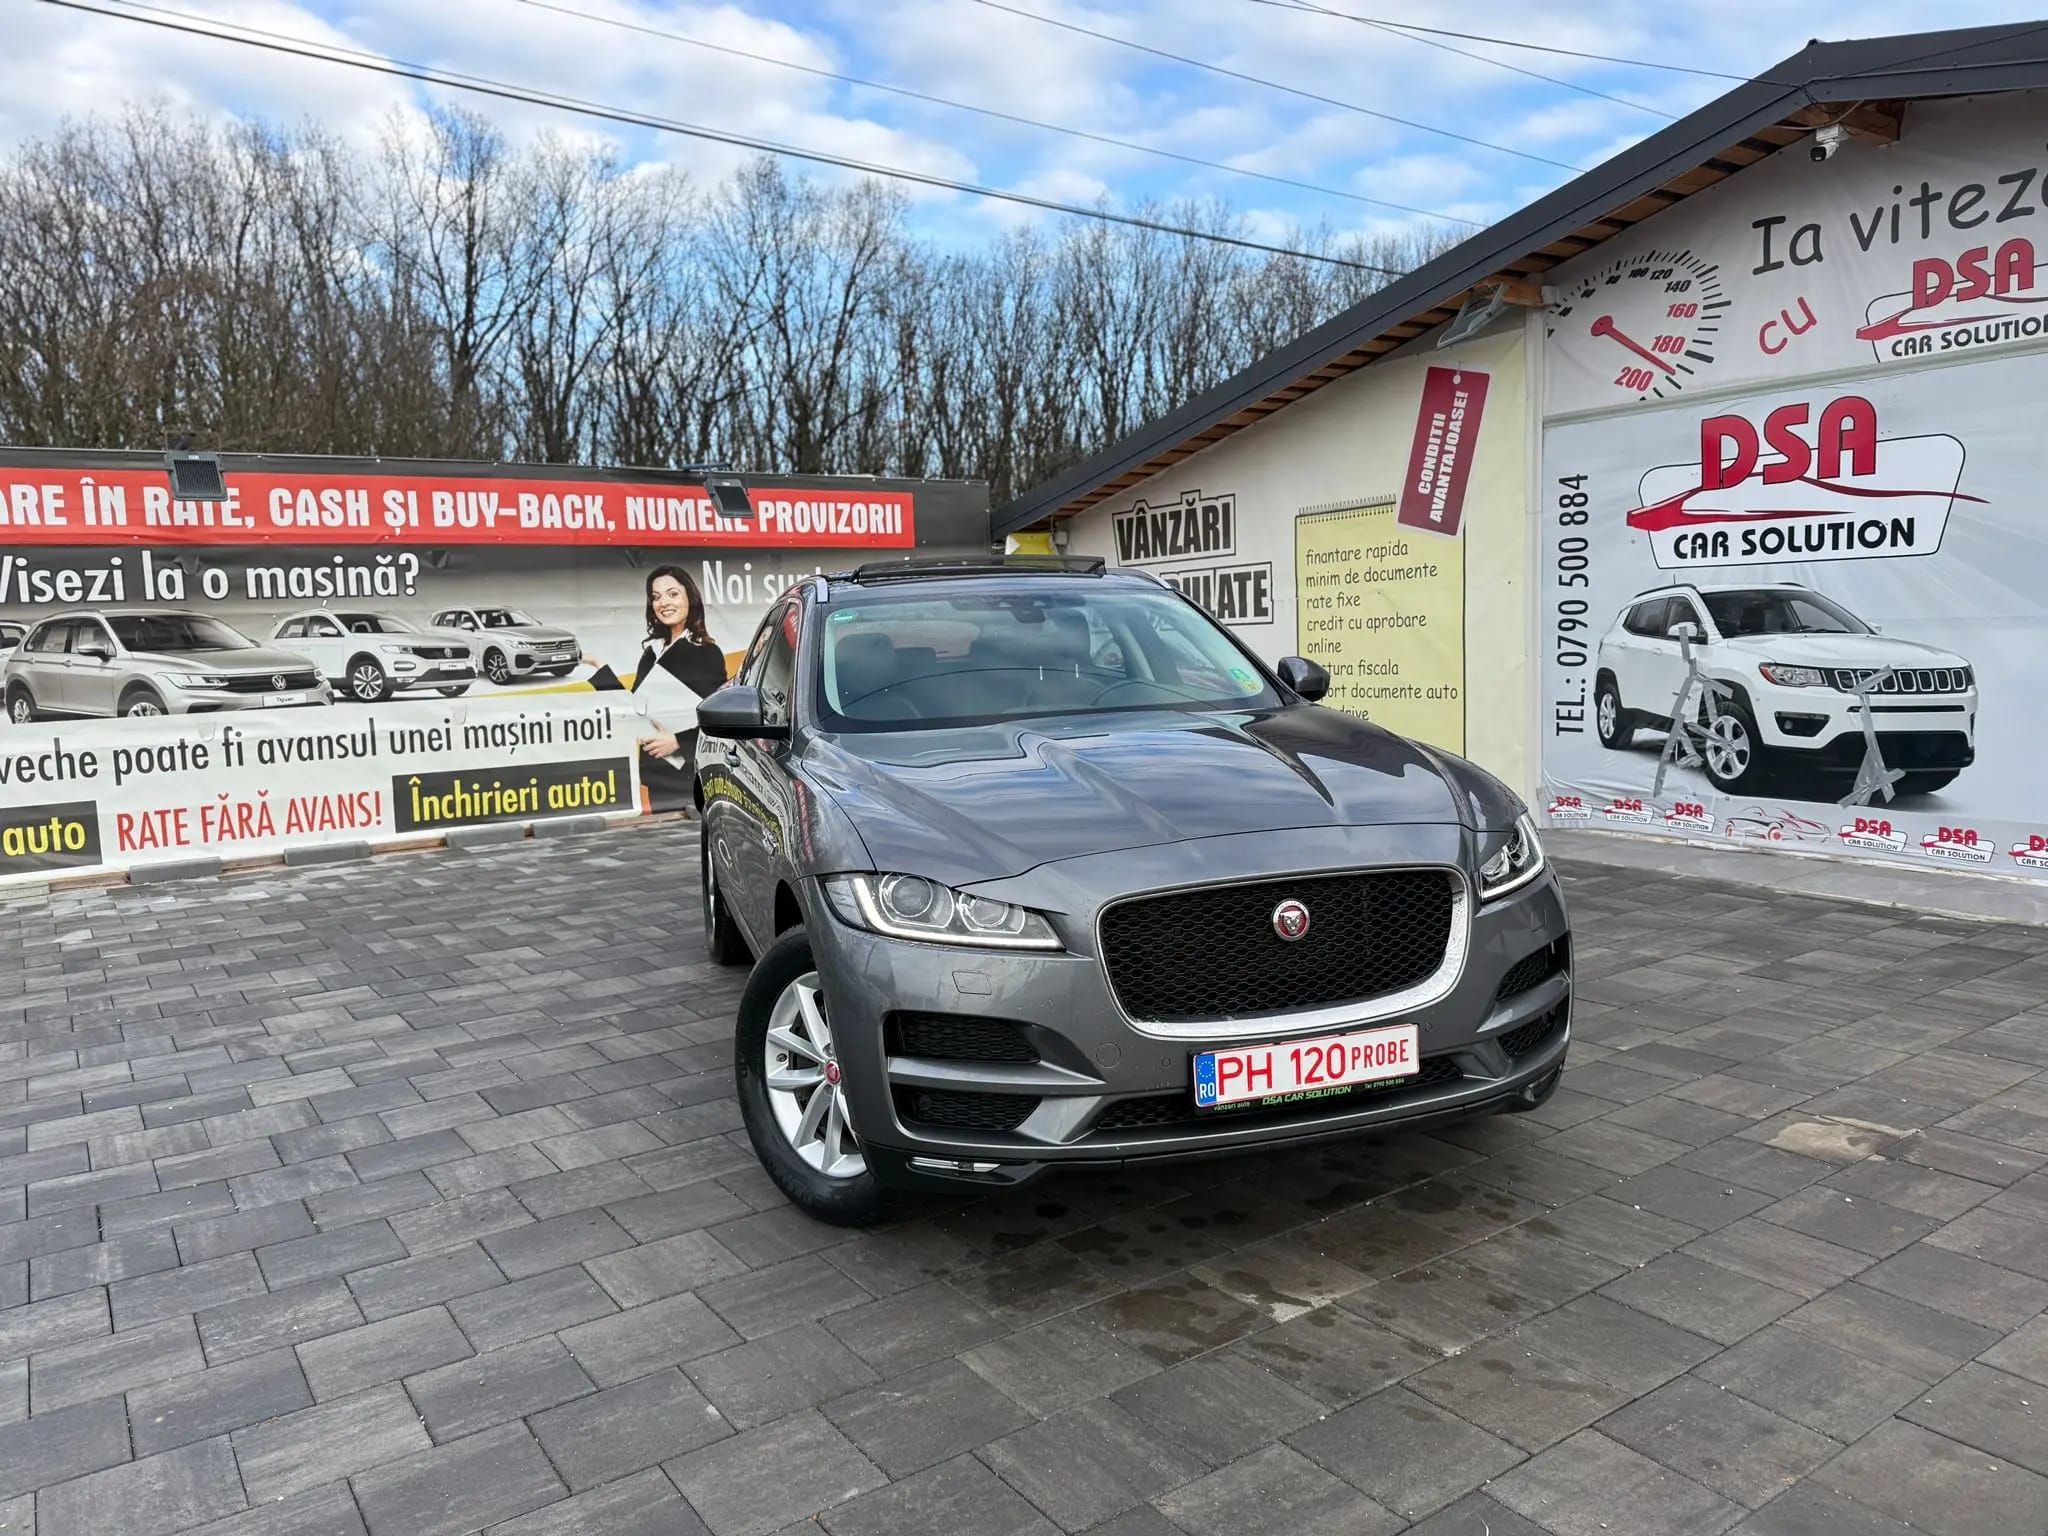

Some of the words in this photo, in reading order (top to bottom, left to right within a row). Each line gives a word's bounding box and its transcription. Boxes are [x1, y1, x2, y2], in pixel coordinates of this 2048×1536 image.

[1649, 268, 1674, 281] 120
[1664, 279, 1691, 293] 140
[1912, 237, 2035, 310] DSA
[1666, 303, 1698, 318] 160
[1759, 296, 1818, 355] cu
[1651, 335, 1686, 354] 180
[1891, 334, 1932, 357] CAR
[1614, 366, 1654, 391] 200
[1417, 413, 1446, 495] CONDITII
[1701, 395, 1877, 490] DSA
[1429, 390, 1469, 523] AVANTAJOASE!
[80, 476, 128, 526] ÎN
[143, 486, 255, 529] RATE,
[269, 487, 370, 527] CASH
[383, 489, 420, 536] ȘI
[432, 491, 616, 532] BUY-BACK,
[758, 500, 903, 534] PROVIZORII
[1558, 474, 1589, 526] 884
[1116, 497, 1231, 561] VÂNZĂRI
[1673, 530, 1729, 560] CAR
[1741, 517, 1915, 555] SOLUTION
[1305, 549, 1361, 566] finantare
[1366, 539, 1408, 562] rapida
[1558, 537, 1589, 588] 500
[141, 550, 185, 600] la
[202, 566, 229, 600] o
[702, 560, 752, 605] Noi
[1306, 571, 1340, 587] minim
[1344, 568, 1360, 584] de
[1364, 562, 1438, 583] documente
[1164, 569, 1269, 619] ULATE
[1306, 595, 1332, 609] rate
[1337, 591, 1361, 608] fixe
[1307, 615, 1344, 631] credit
[1348, 617, 1362, 630] cu
[1366, 612, 1427, 633] aprobare
[1557, 600, 1589, 667] 0790
[1307, 638, 1342, 653] online
[1322, 661, 1353, 676] tura
[1358, 658, 1399, 676] fiscala
[1350, 682, 1422, 699] documente
[1426, 684, 1458, 699] auto
[0, 737, 98, 784] veche
[113, 738, 210, 785] poate
[222, 726, 244, 767] fi
[257, 717, 377, 765] avansul
[389, 718, 452, 754] unei
[464, 712, 553, 754] mașini
[564, 707, 612, 742] noi!
[408, 776, 538, 823] Închirieri
[548, 769, 617, 809] auto!
[116, 807, 191, 852] RATE
[200, 788, 276, 844] FĂRĂ
[285, 791, 382, 834] AVANS!
[1675, 802, 1704, 818] DSA
[3, 817, 86, 856] auto
[1855, 817, 1892, 837] DSA
[1938, 826, 1978, 846] DSA
[1863, 840, 1899, 851] SOLUTION
[1947, 851, 1986, 861] SOLUTION
[2029, 835, 2048, 851] D
[1217, 1052, 1273, 1096] PH
[1290, 1043, 1346, 1085] 120
[1351, 1039, 1409, 1070] PROBE
[1200, 1082, 1215, 1099] RO
[1262, 1096, 1283, 1105] DSA
[1285, 1092, 1304, 1102] CAR
[1305, 1085, 1352, 1099] SOLUTION
